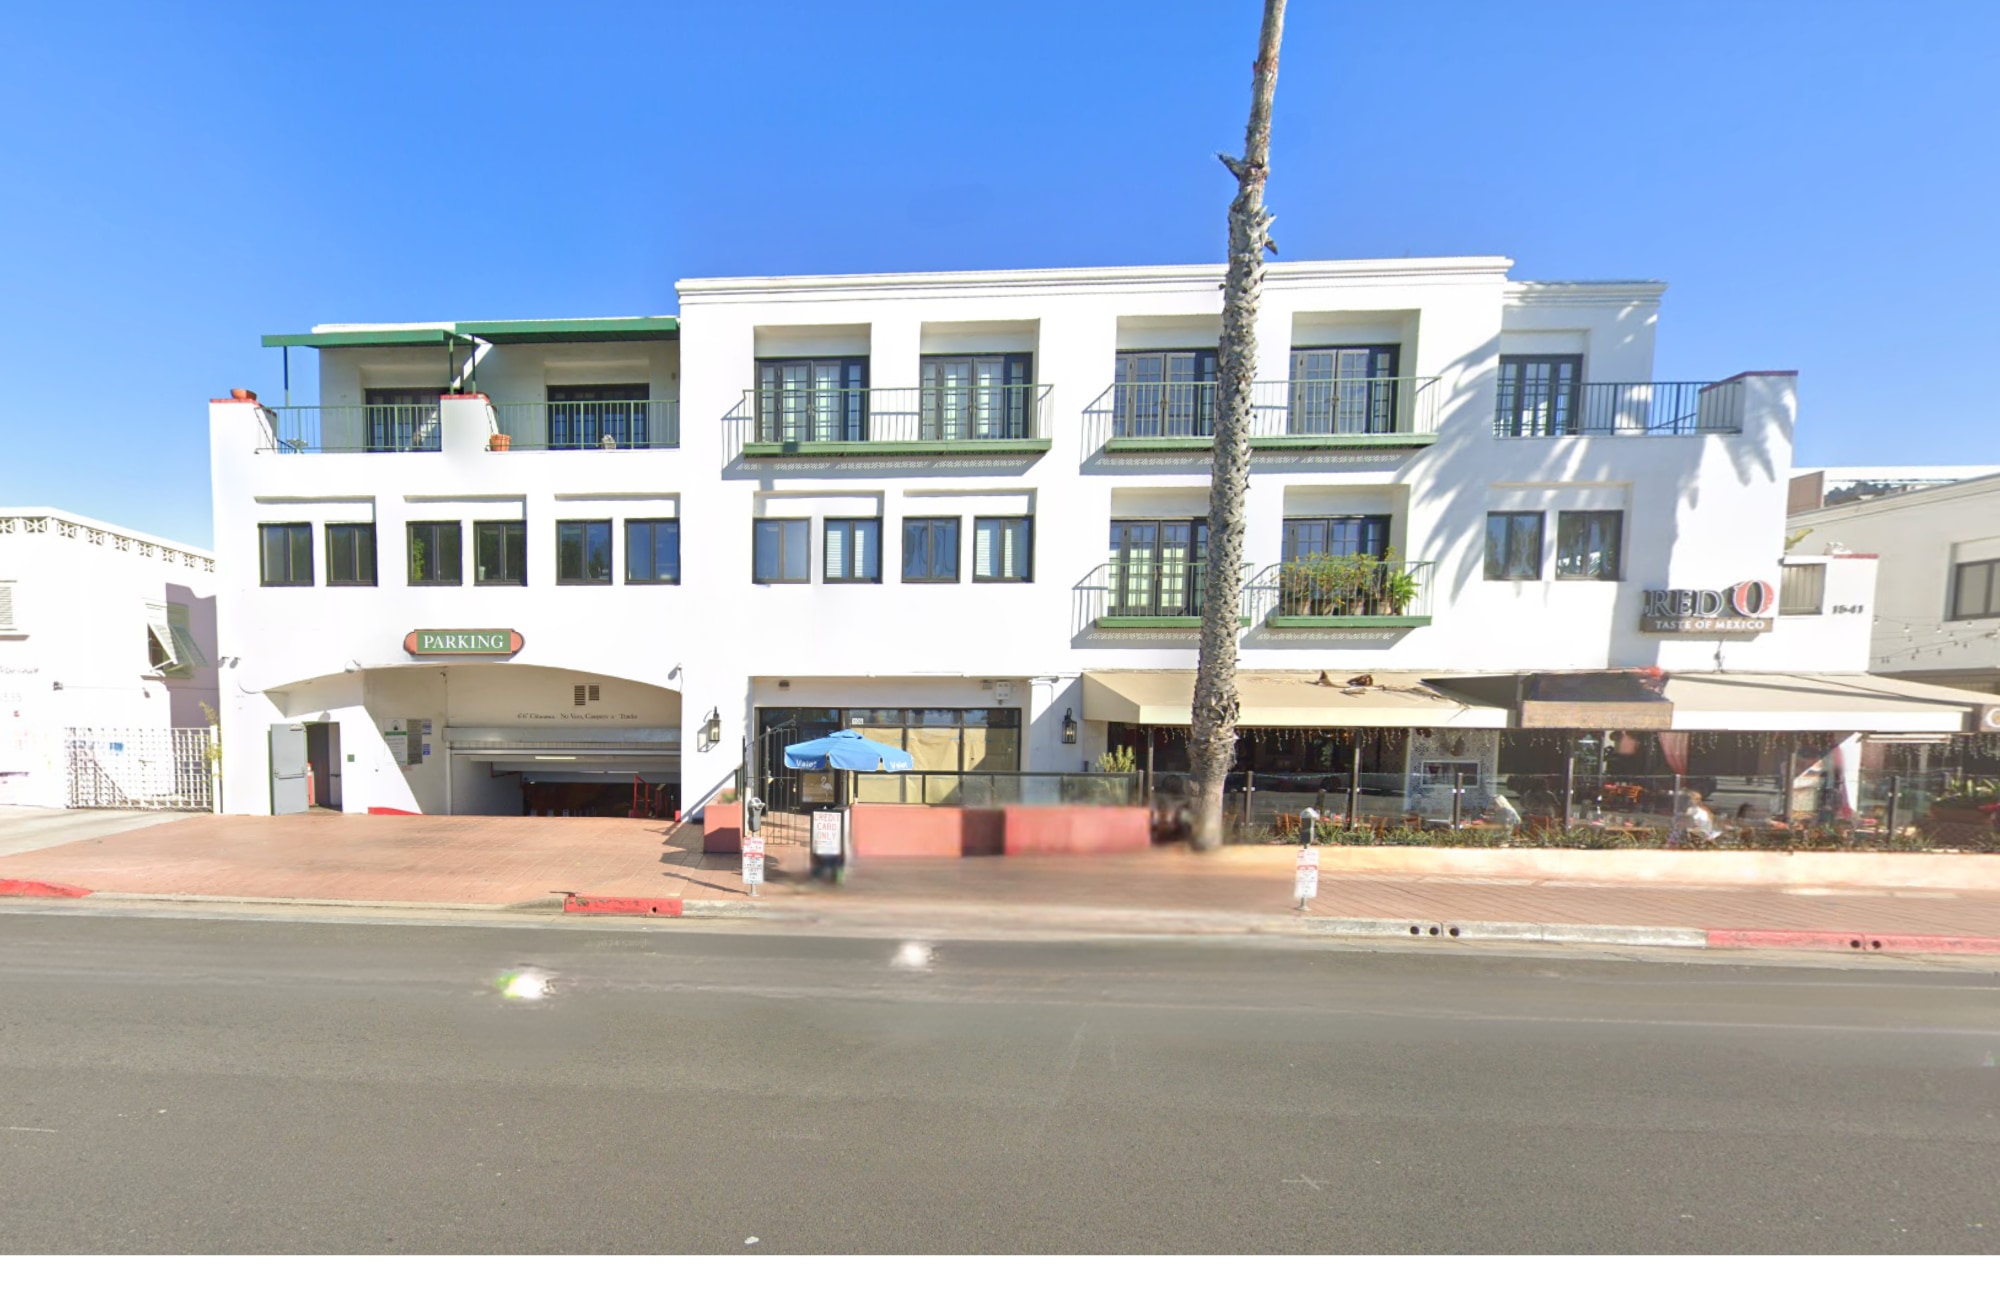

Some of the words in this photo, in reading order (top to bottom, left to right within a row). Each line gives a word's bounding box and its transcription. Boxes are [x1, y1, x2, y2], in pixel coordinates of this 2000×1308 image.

[1647, 590, 1725, 617] RED
[1655, 621, 1691, 630] TASTE
[1694, 620, 1712, 630] OF
[1715, 620, 1765, 630] MEXICO
[423, 634, 505, 649] PARKING
[796, 758, 817, 768] Valet
[889, 760, 908, 769] Valet
[814, 813, 840, 822] CREDIT
[816, 822, 837, 831] CARD
[816, 831, 837, 840] ONLY
